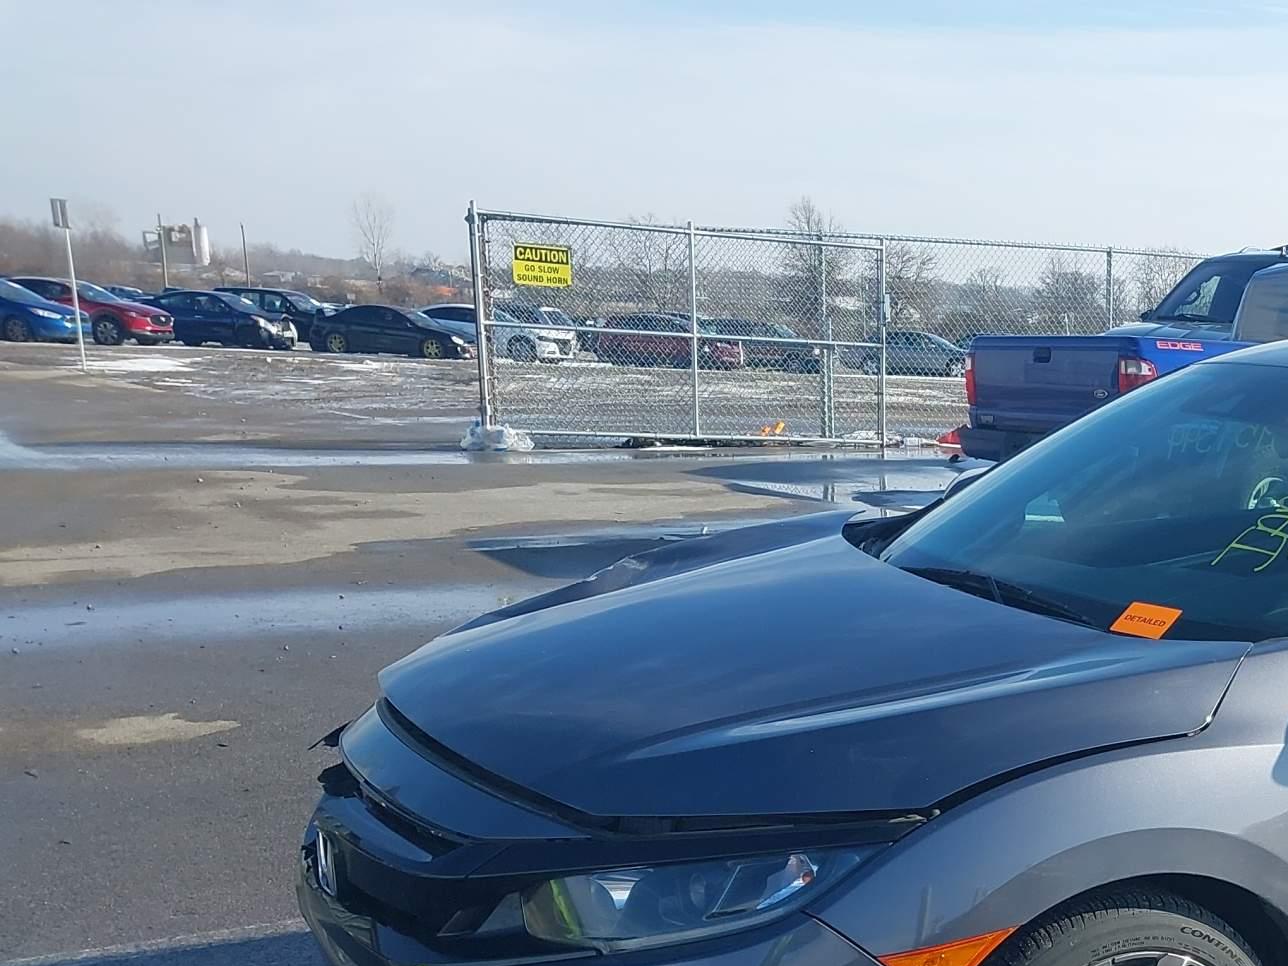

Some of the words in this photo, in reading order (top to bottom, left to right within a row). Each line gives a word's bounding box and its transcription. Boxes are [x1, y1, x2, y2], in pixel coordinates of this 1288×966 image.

[516, 247, 567, 264] CAUTION
[524, 264, 536, 272] GO
[538, 265, 560, 274] SLOW
[516, 273, 544, 284] SOUND
[546, 276, 568, 285] HORN
[1156, 340, 1205, 352] EDGE
[1123, 614, 1167, 628] DETAILED
